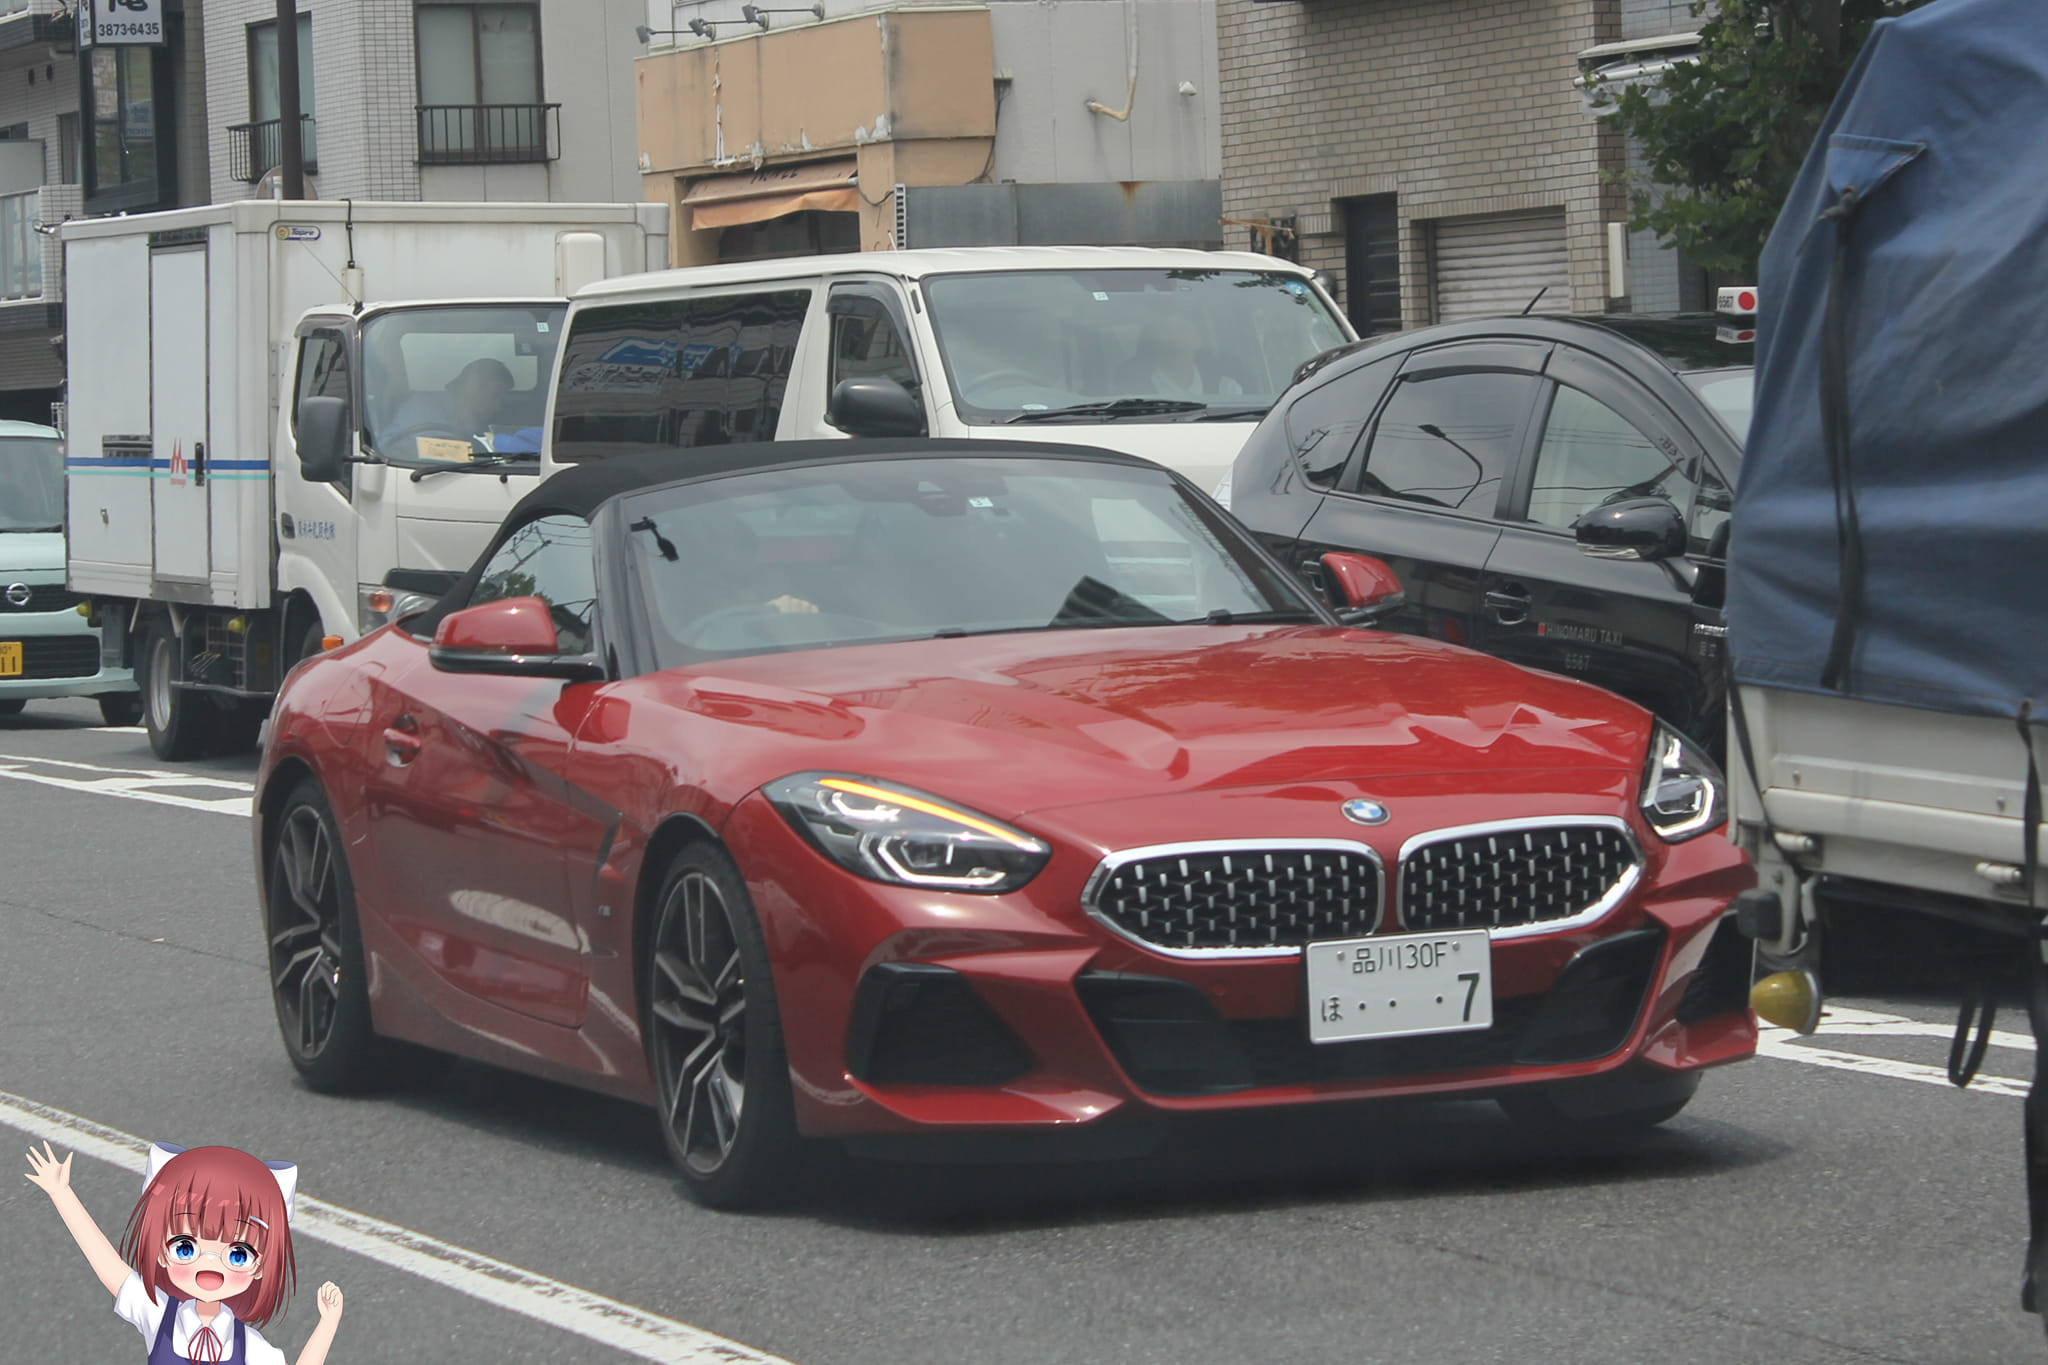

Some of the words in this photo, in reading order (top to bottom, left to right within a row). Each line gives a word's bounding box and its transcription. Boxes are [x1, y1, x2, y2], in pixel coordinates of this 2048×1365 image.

[98, 23, 160, 36] 3873-6435
[1547, 622, 1597, 643] HINOMARU
[1600, 629, 1624, 647] TAXI
